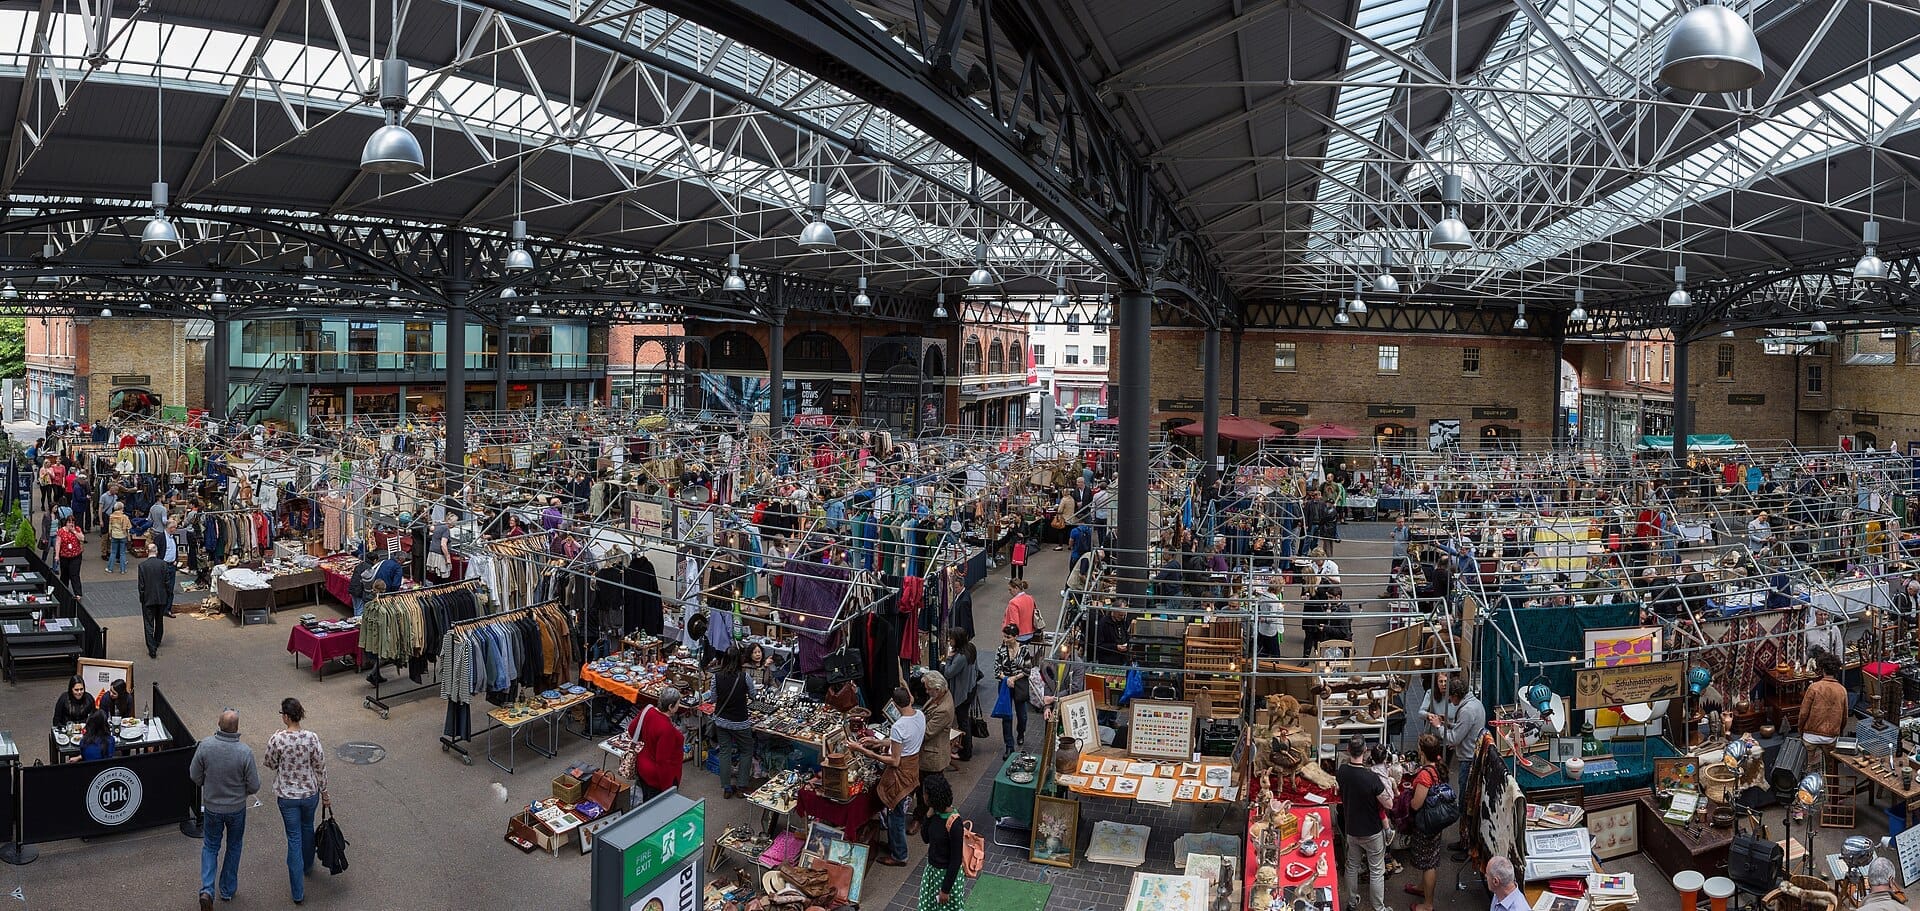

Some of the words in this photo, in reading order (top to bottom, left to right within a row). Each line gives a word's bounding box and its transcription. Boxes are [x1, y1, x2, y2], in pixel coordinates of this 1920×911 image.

[801, 407, 823, 415] COMING
[96, 772, 118, 790] gourmet
[118, 771, 135, 785] burger
[102, 786, 127, 807] gbk
[104, 810, 127, 820] kitchen
[635, 848, 652, 865] FIRE
[635, 859, 652, 876] EXIT
